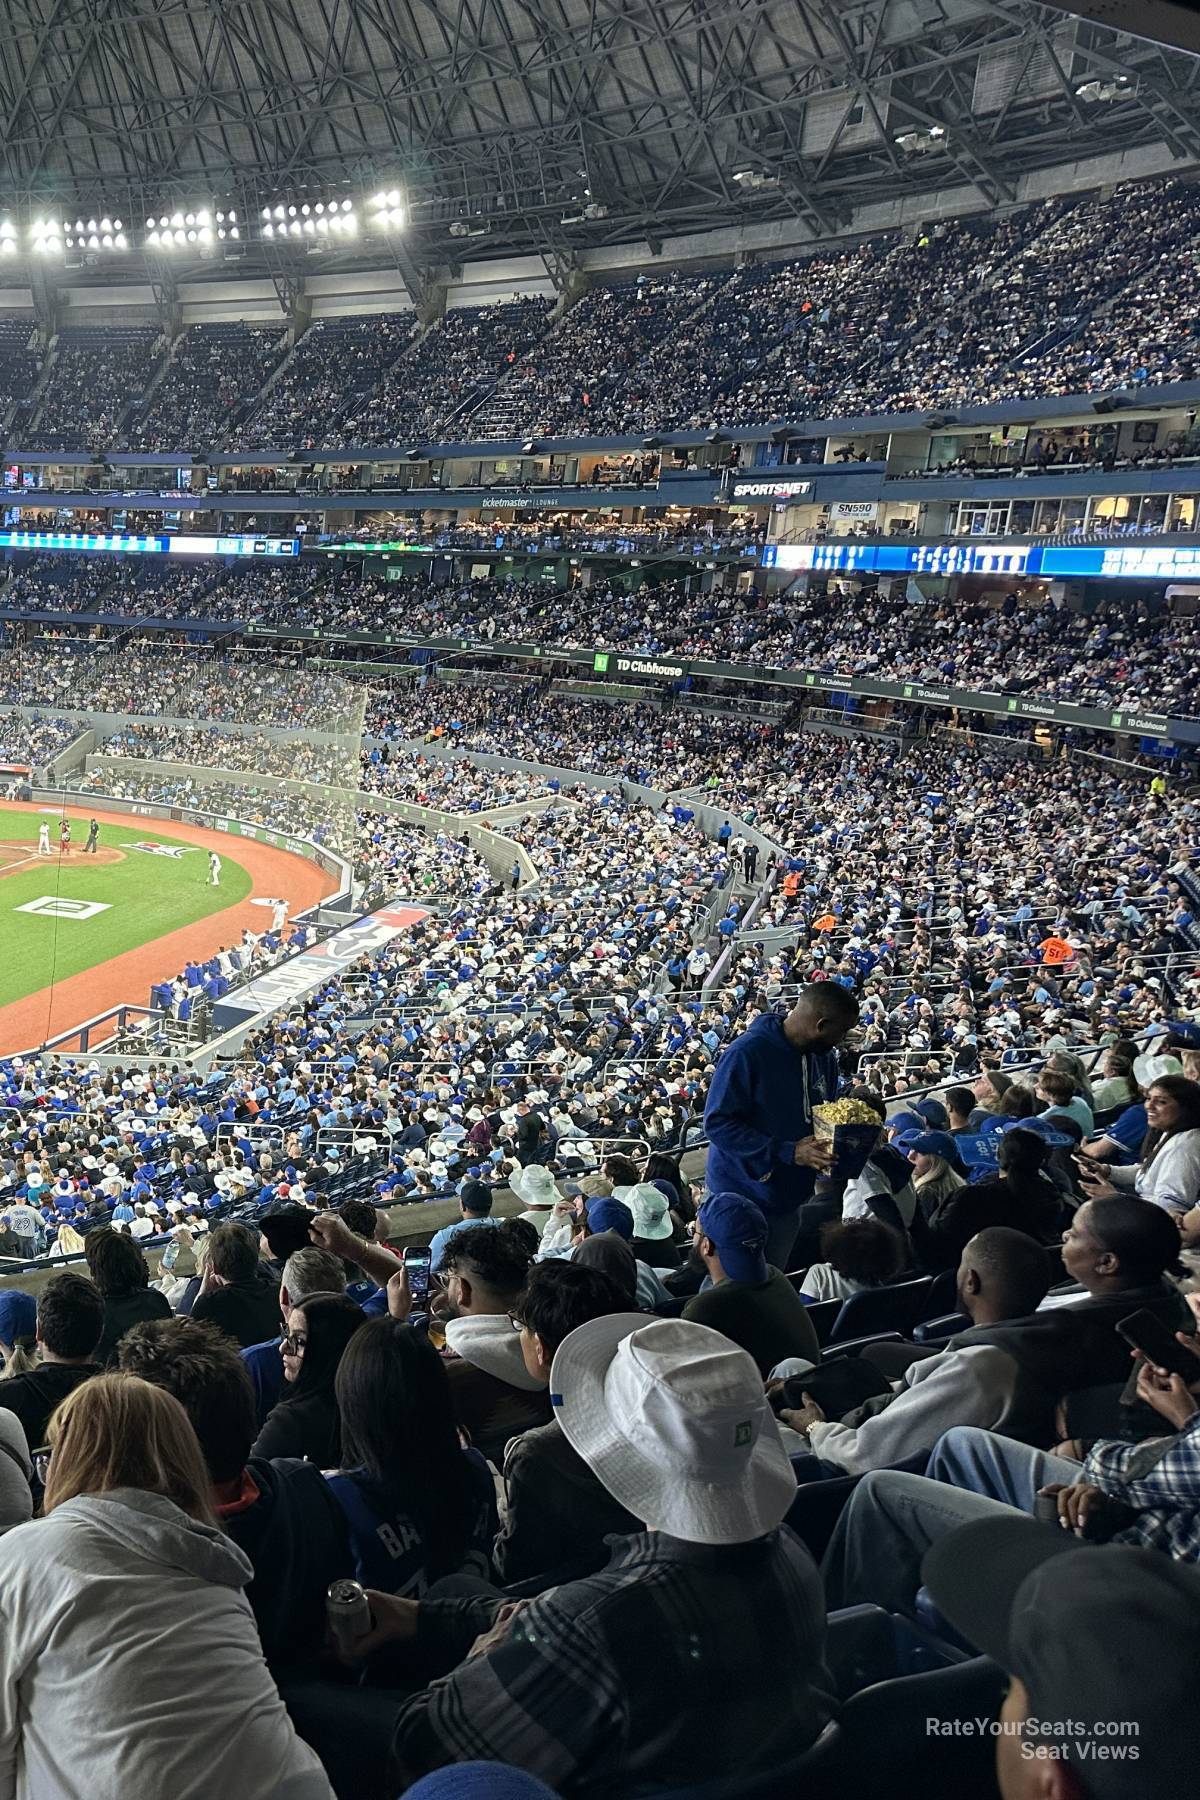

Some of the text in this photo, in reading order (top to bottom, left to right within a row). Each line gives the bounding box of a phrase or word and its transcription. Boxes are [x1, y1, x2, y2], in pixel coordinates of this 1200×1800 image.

[733, 482, 811, 496] SPORTSNET
[482, 497, 529, 507] ticketmaster
[838, 503, 873, 513] SN590
[617, 659, 682, 677] TD Clubhouse
[827, 678, 851, 687] Clubhouse
[925, 690, 950, 700] Clubhouse
[1030, 704, 1055, 714] Clubhouse
[1136, 719, 1167, 731] Clubhouse
[14, 1217, 30, 1231] 29
